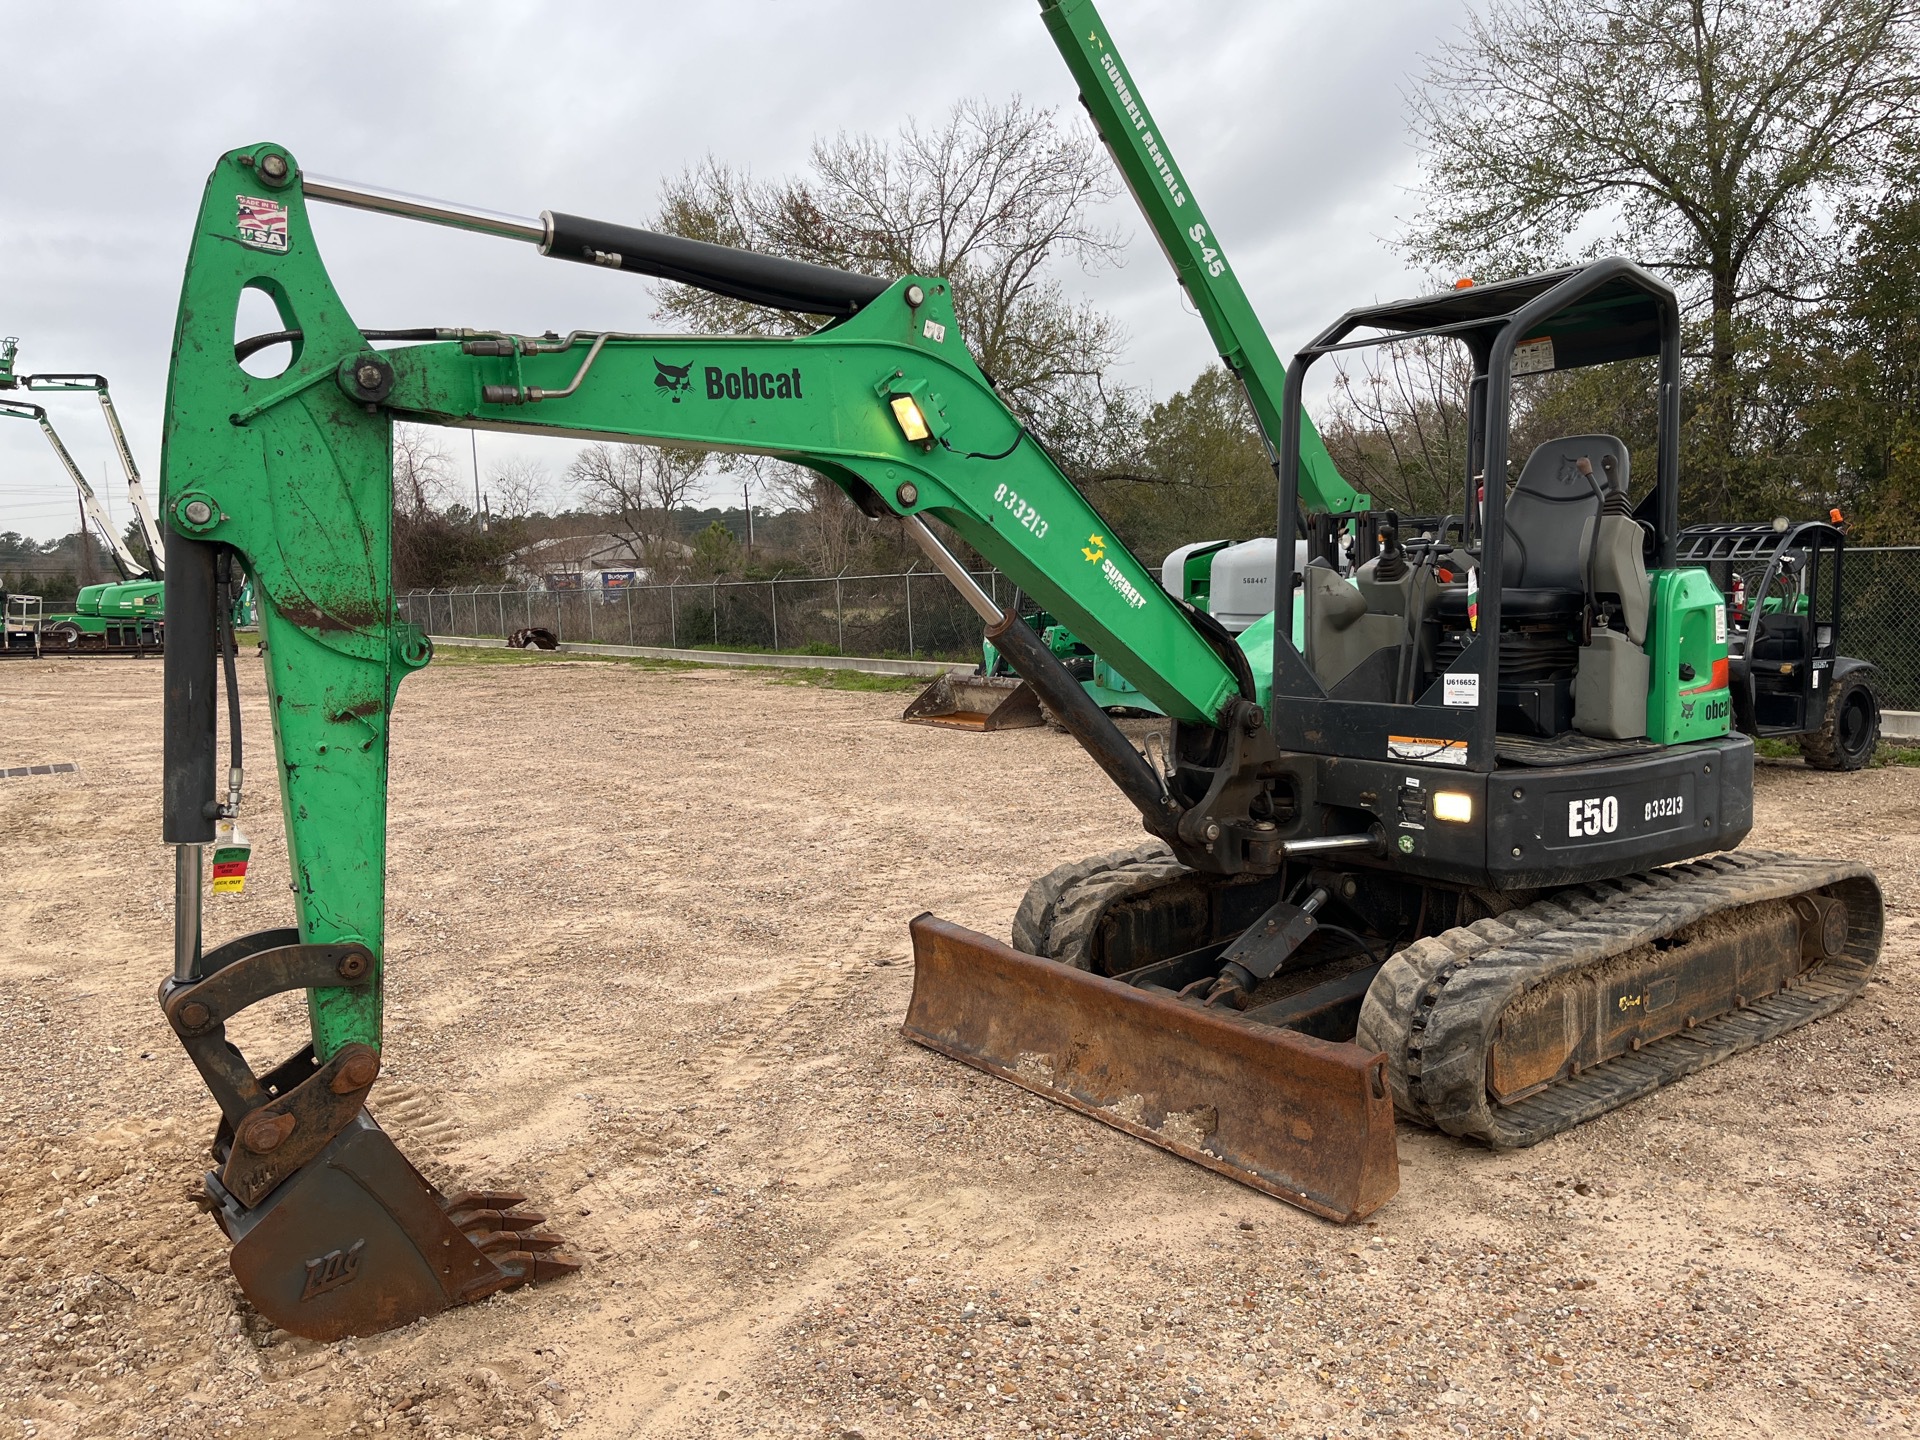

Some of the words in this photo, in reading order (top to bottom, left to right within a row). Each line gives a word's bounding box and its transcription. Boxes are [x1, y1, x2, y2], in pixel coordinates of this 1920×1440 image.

[1100, 53, 1147, 131] SUNBELT
[1141, 130, 1186, 208] RENTALS
[239, 228, 283, 246] USA
[1188, 222, 1226, 279] S-45
[704, 366, 803, 400] Bobcat
[993, 483, 1049, 539] 833213
[607, 573, 629, 581] Budget
[1101, 558, 1147, 609] SUNBELT
[1104, 574, 1135, 608] RENTALS
[1568, 796, 1618, 837] E50
[1644, 795, 1684, 821] 833213
